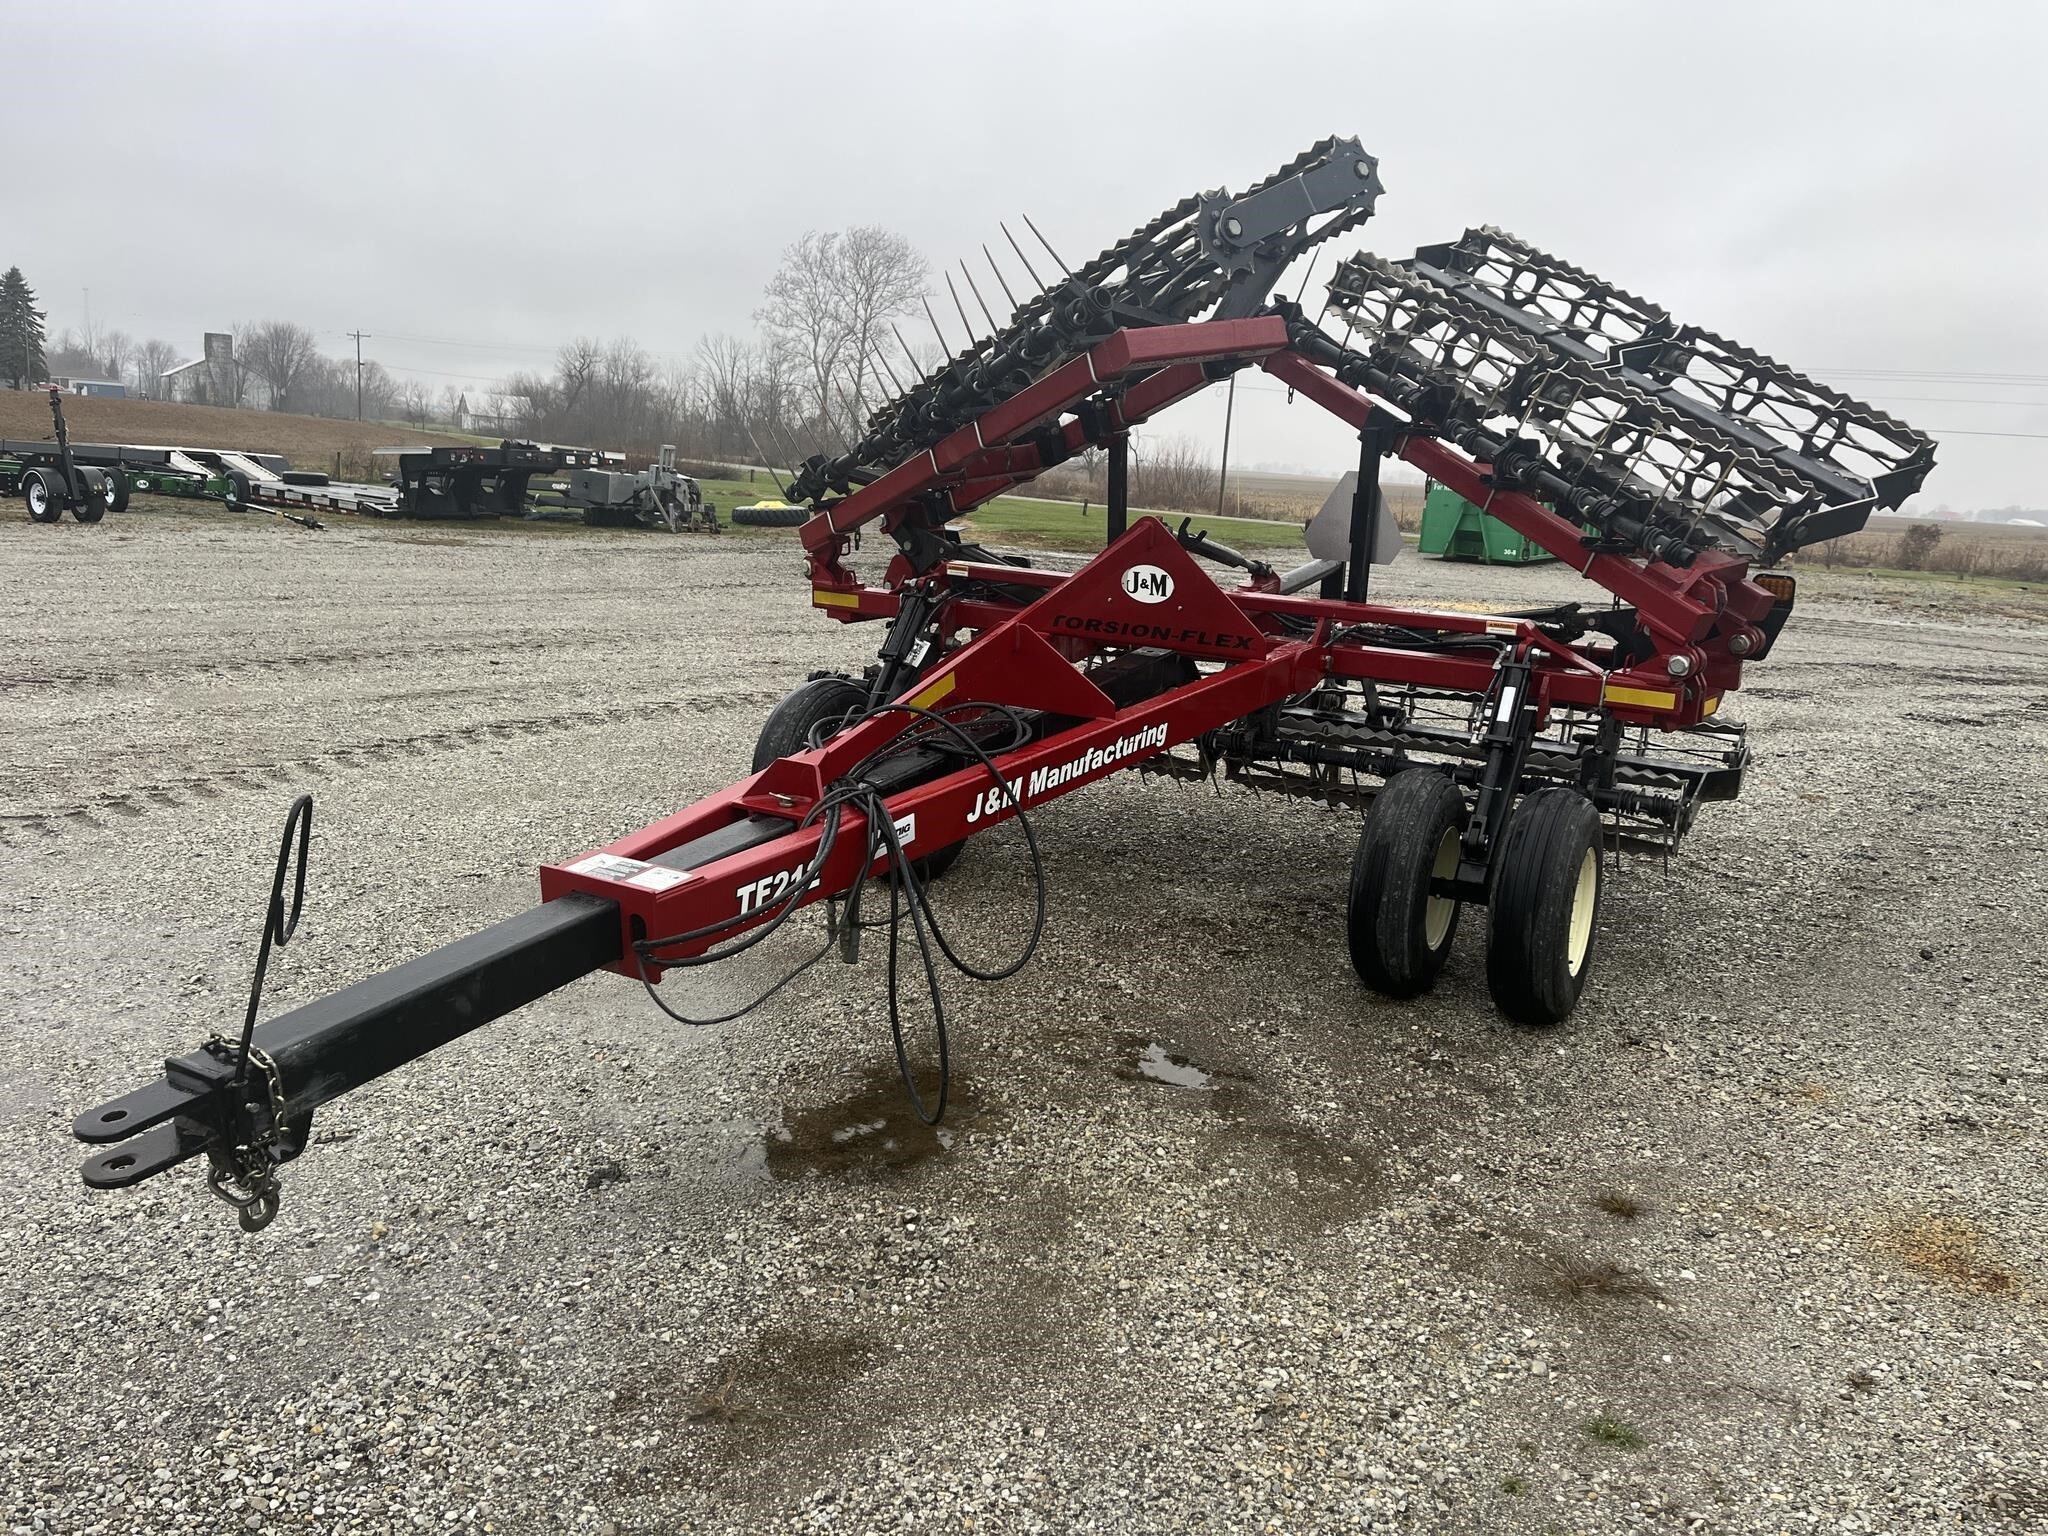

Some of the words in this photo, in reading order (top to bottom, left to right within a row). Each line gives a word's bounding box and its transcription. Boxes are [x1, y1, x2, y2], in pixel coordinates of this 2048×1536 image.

[1126, 571, 1168, 597] J&M
[1052, 614, 1255, 650] TORSION-FLEX
[1028, 722, 1168, 797] Manufacturing
